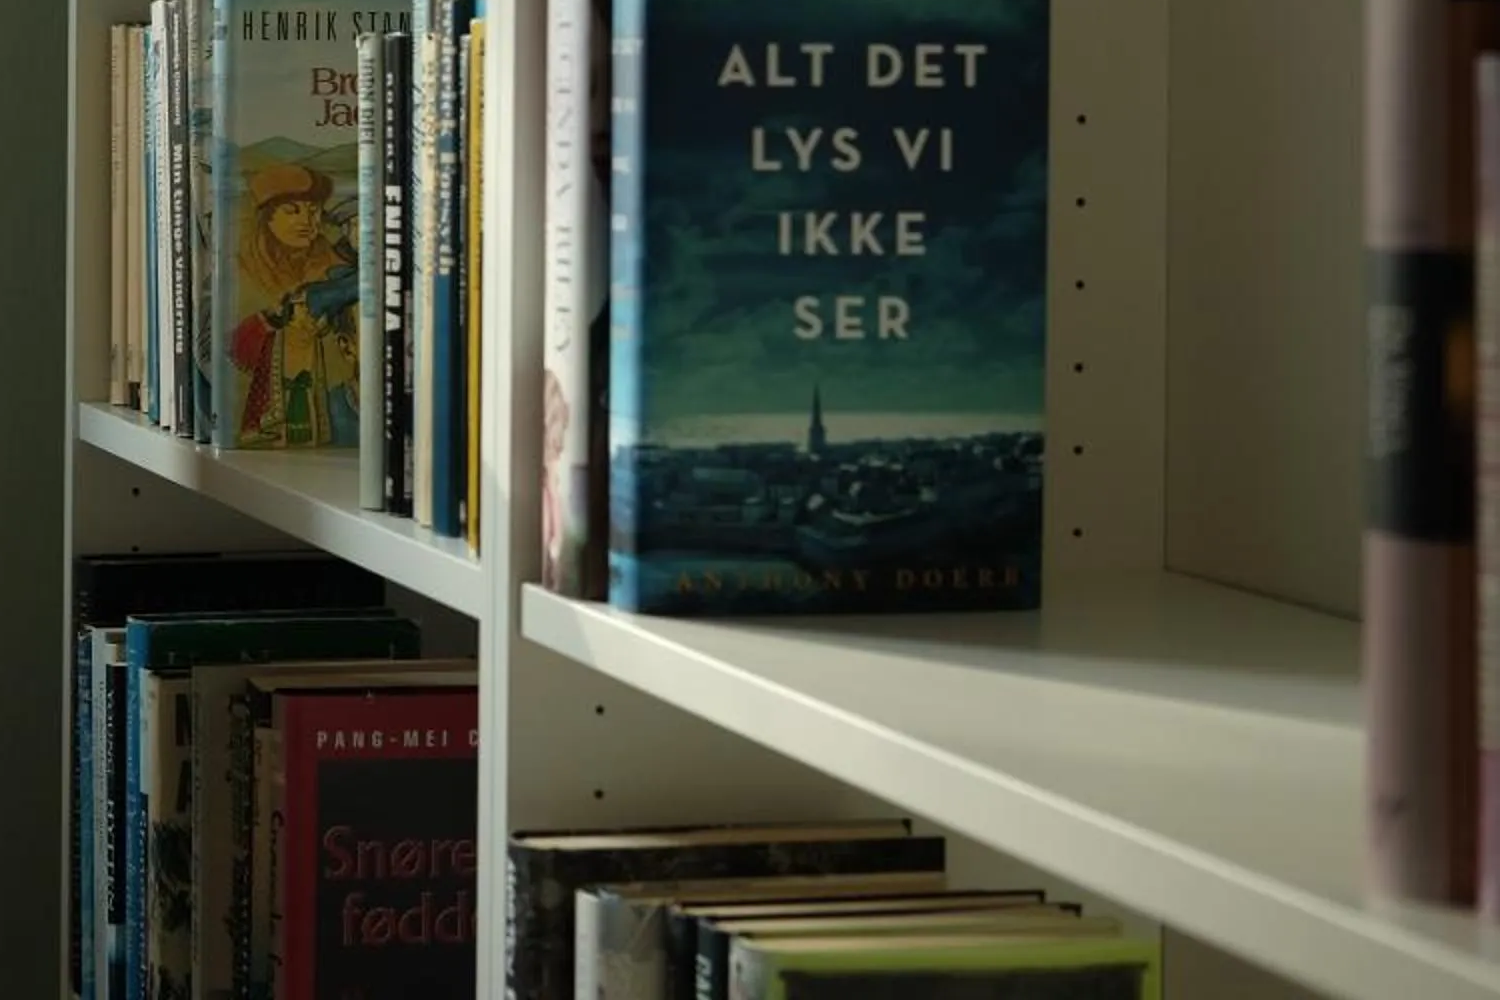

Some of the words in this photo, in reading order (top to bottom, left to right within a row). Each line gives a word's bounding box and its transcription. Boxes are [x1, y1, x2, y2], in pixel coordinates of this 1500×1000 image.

[242, 10, 338, 43] HENRIK
[717, 43, 836, 88] ALT
[866, 43, 989, 88] DET
[315, 99, 358, 127] Ja
[751, 126, 863, 172] LYS
[891, 126, 953, 172] VI
[777, 211, 927, 256] IKKE
[384, 184, 403, 332] ENIGMA
[792, 295, 911, 340] SER
[676, 565, 871, 594] ANTHONY
[315, 728, 449, 750] PANG-MEI
[342, 889, 477, 948] fødd
